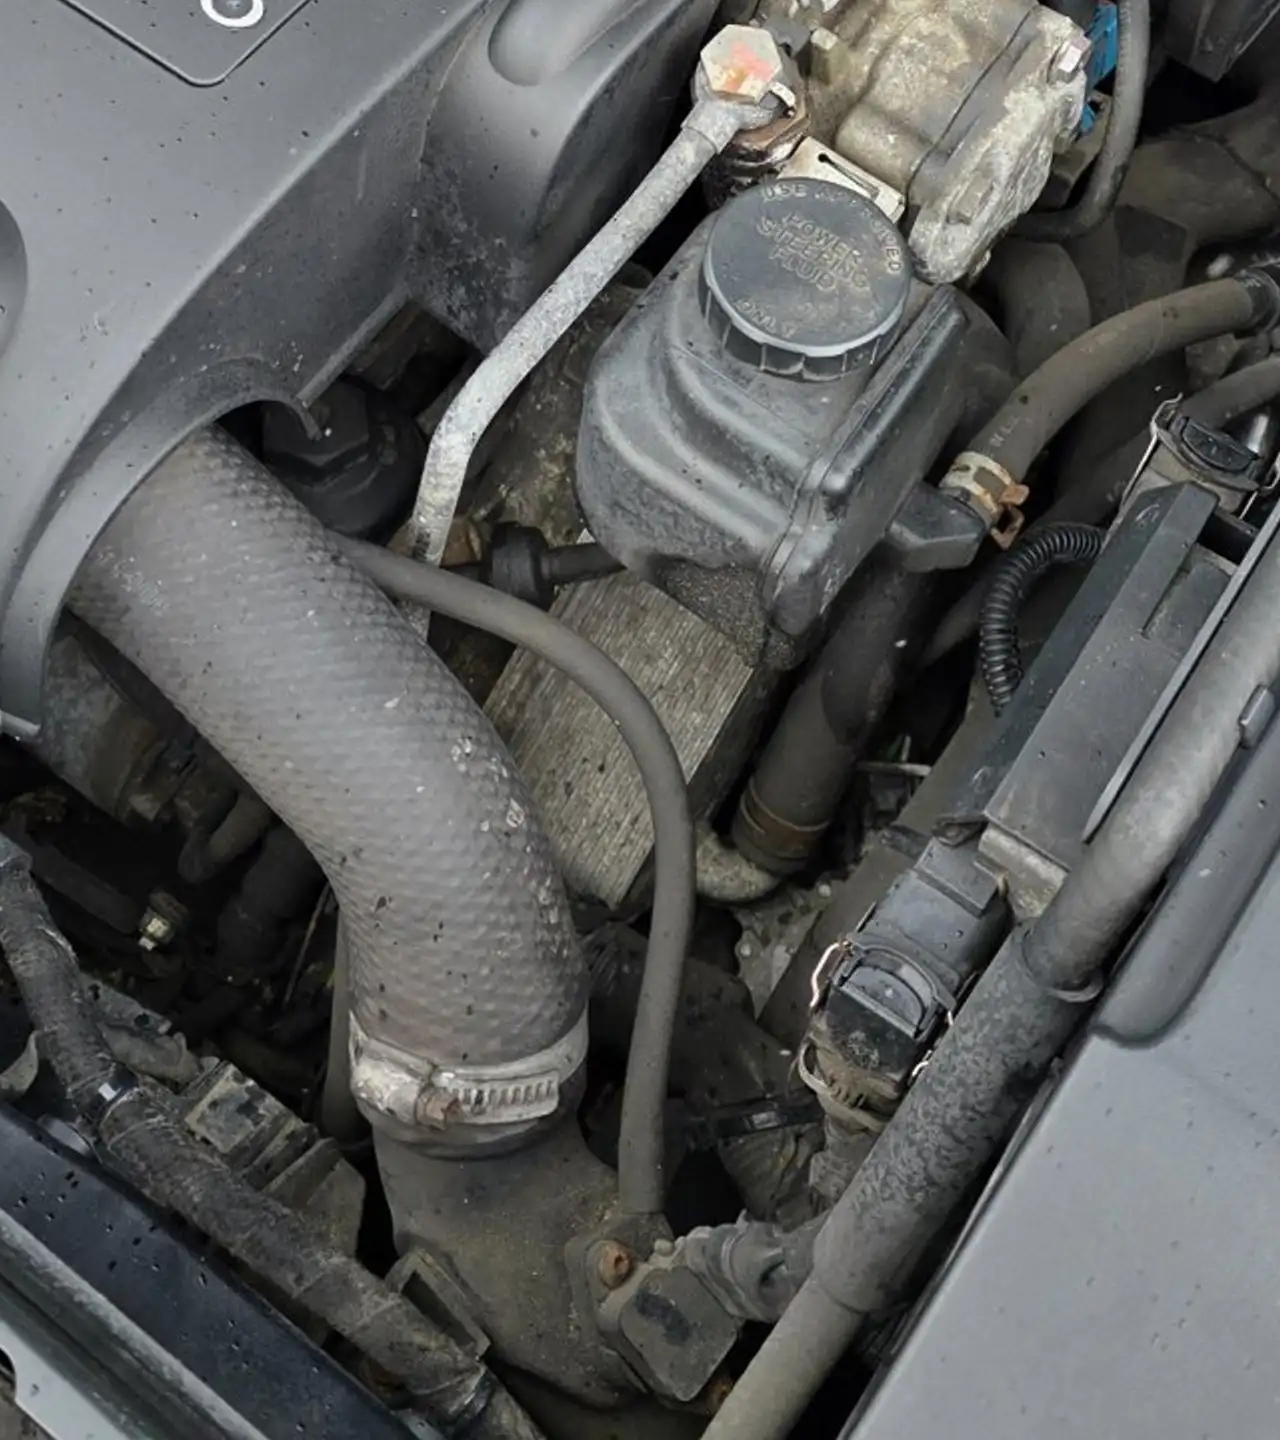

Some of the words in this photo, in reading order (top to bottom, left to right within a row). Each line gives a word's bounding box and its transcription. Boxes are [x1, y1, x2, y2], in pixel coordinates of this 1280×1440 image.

[762, 183, 808, 203] USE
[756, 215, 870, 291] STEERING
[780, 211, 863, 262] POWER
